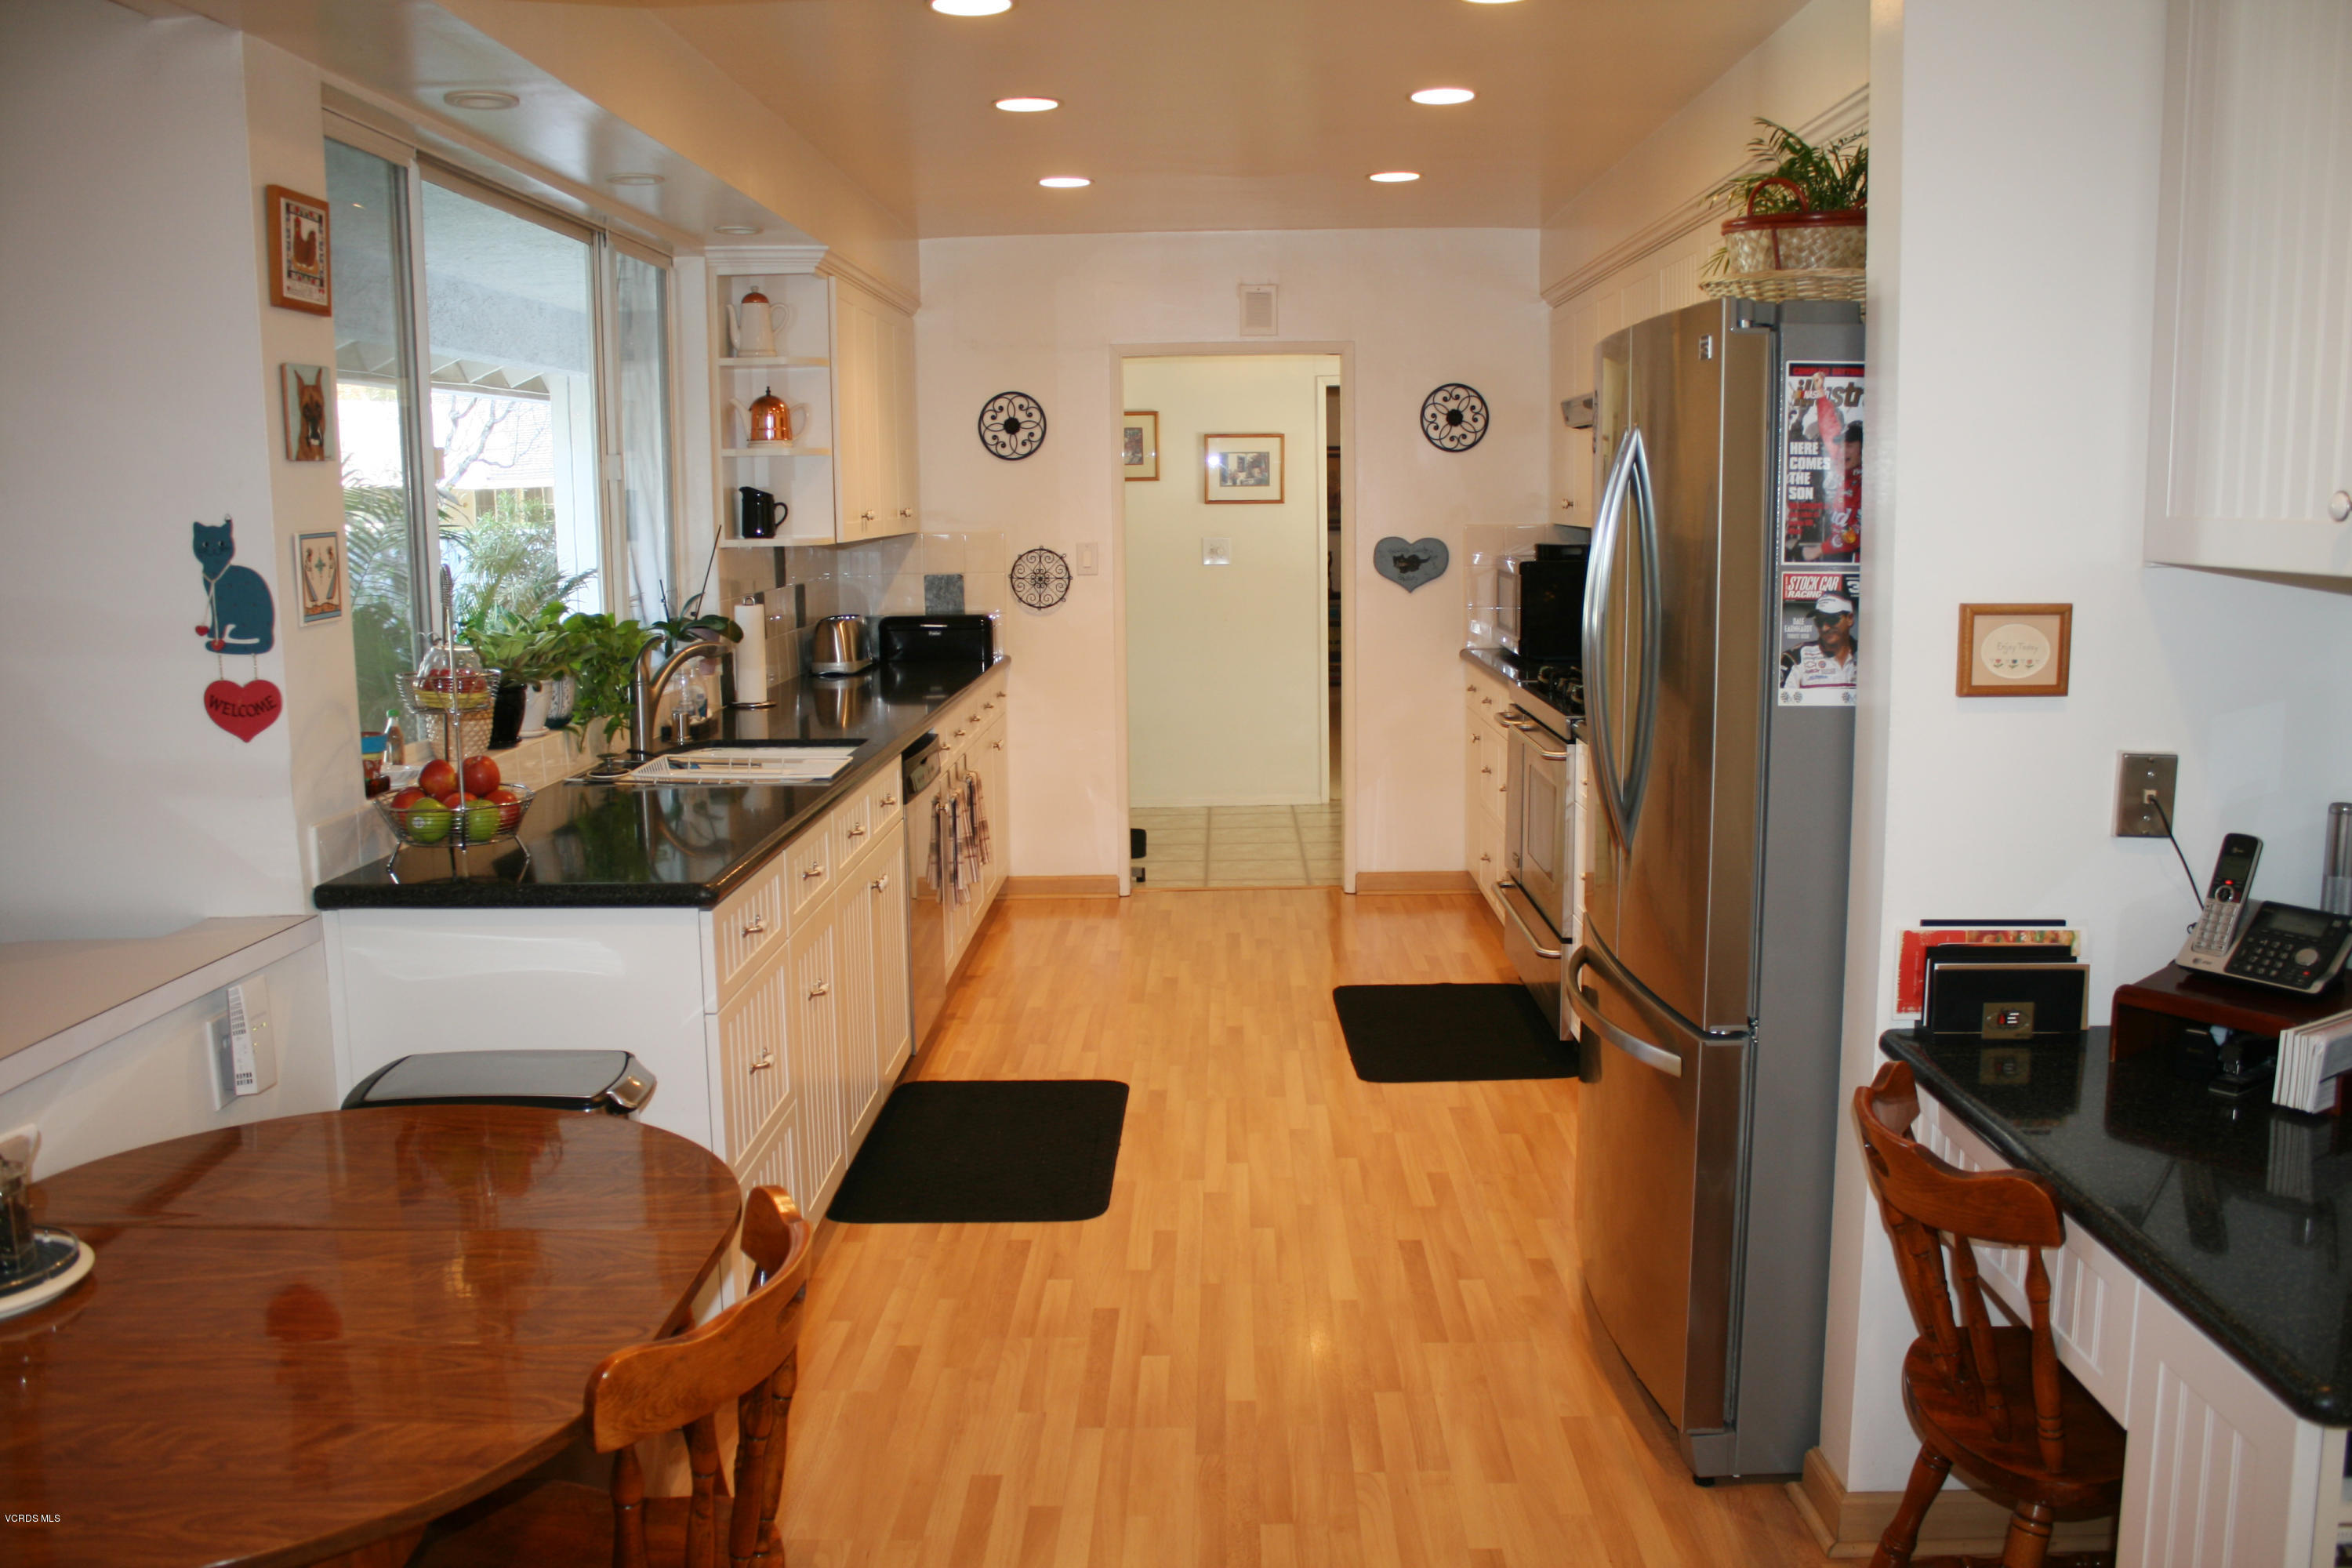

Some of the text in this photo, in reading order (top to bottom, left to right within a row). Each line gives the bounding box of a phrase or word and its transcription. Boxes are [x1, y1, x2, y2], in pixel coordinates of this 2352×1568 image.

[1789, 441, 1819, 456] HERE
[1789, 457, 1831, 470] COMES
[1788, 472, 1812, 485] THE
[1788, 487, 1814, 501] SON
[1788, 576, 1820, 591] STOCK
[1820, 576, 1840, 591] CAR
[209, 695, 277, 718] WELCOME
